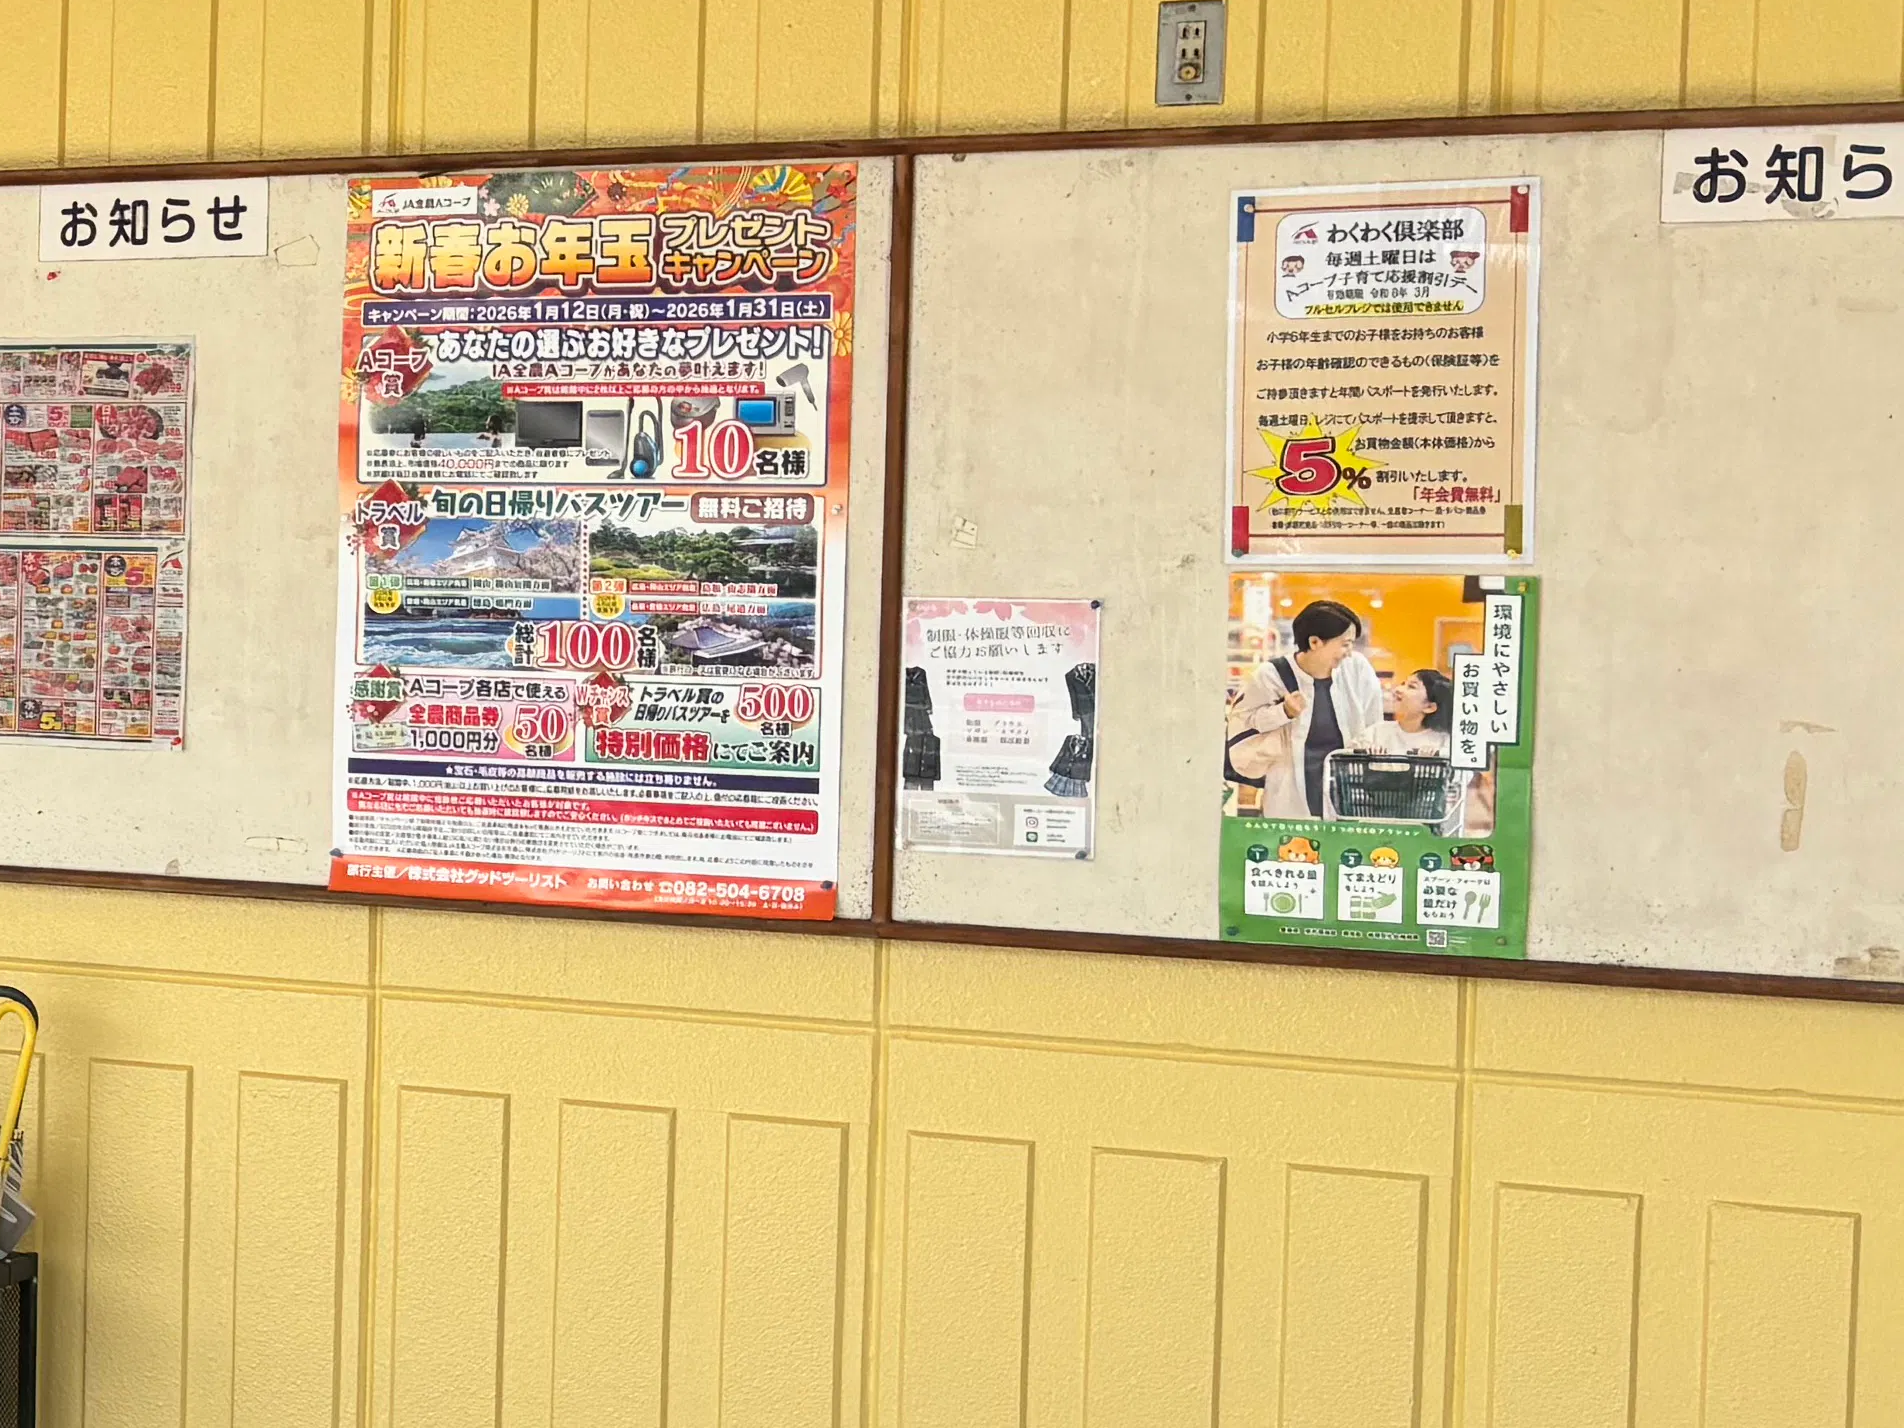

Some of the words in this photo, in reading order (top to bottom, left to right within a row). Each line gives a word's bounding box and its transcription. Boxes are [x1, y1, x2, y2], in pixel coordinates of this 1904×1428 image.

[60, 194, 247, 248] お知らせ
[664, 213, 832, 249] プレゼント
[1327, 219, 1464, 244] わくわく倶楽部
[374, 220, 654, 289] 新春お年玉
[1325, 249, 1437, 267] 毎週土曜日は
[662, 250, 826, 285] キャンペーン
[438, 326, 822, 361] あなたの選ぶお好きなプレゼント!
[1266, 326, 1484, 344] 小学6年生までのお子様をお持ちのお客様
[358, 348, 430, 373] Aコープ
[383, 374, 403, 397] 賞
[1355, 436, 1495, 451] お買物金額(本体価格)から
[1275, 436, 1372, 496] 5%
[1376, 469, 1468, 483] 割引いたします。
[431, 489, 686, 521] 旬の日帰りバスツアー
[1413, 486, 1501, 504] 「年会費無料」
[354, 501, 423, 524] トラベル
[697, 497, 808, 521] 無料ご招待
[379, 526, 400, 550] 賞
[515, 624, 534, 665] 総計
[537, 620, 635, 669] 100
[926, 625, 1071, 643] 制服・体操服等回収に
[637, 625, 658, 668] 名様
[929, 643, 1065, 659] ご協力お願いします
[1491, 604, 1513, 733] 環境にやさしい
[354, 679, 403, 700] 感謝賞
[409, 678, 567, 700] Aコープ各店で使える
[641, 687, 724, 704] トラベル賞の
[634, 704, 730, 723] 日帰りバスツアーを
[739, 684, 814, 721] 500
[1459, 663, 1480, 763] お買い物を。
[409, 704, 500, 727] 全農商品券
[514, 705, 567, 744] 50
[410, 729, 500, 751] 1,000円分
[761, 722, 792, 736] 名様
[525, 745, 553, 758] 名様
[595, 729, 815, 764] 特別価格にてご案内
[1251, 867, 1317, 882] 食べきれる量
[1343, 872, 1397, 885] てまえどり
[588, 878, 654, 892] お問い合わせ
[672, 878, 805, 902] 082-504-6708
[1422, 885, 1458, 897] 必要な
[1422, 898, 1458, 910] 量だけ
[1422, 911, 1455, 920] もらおう
